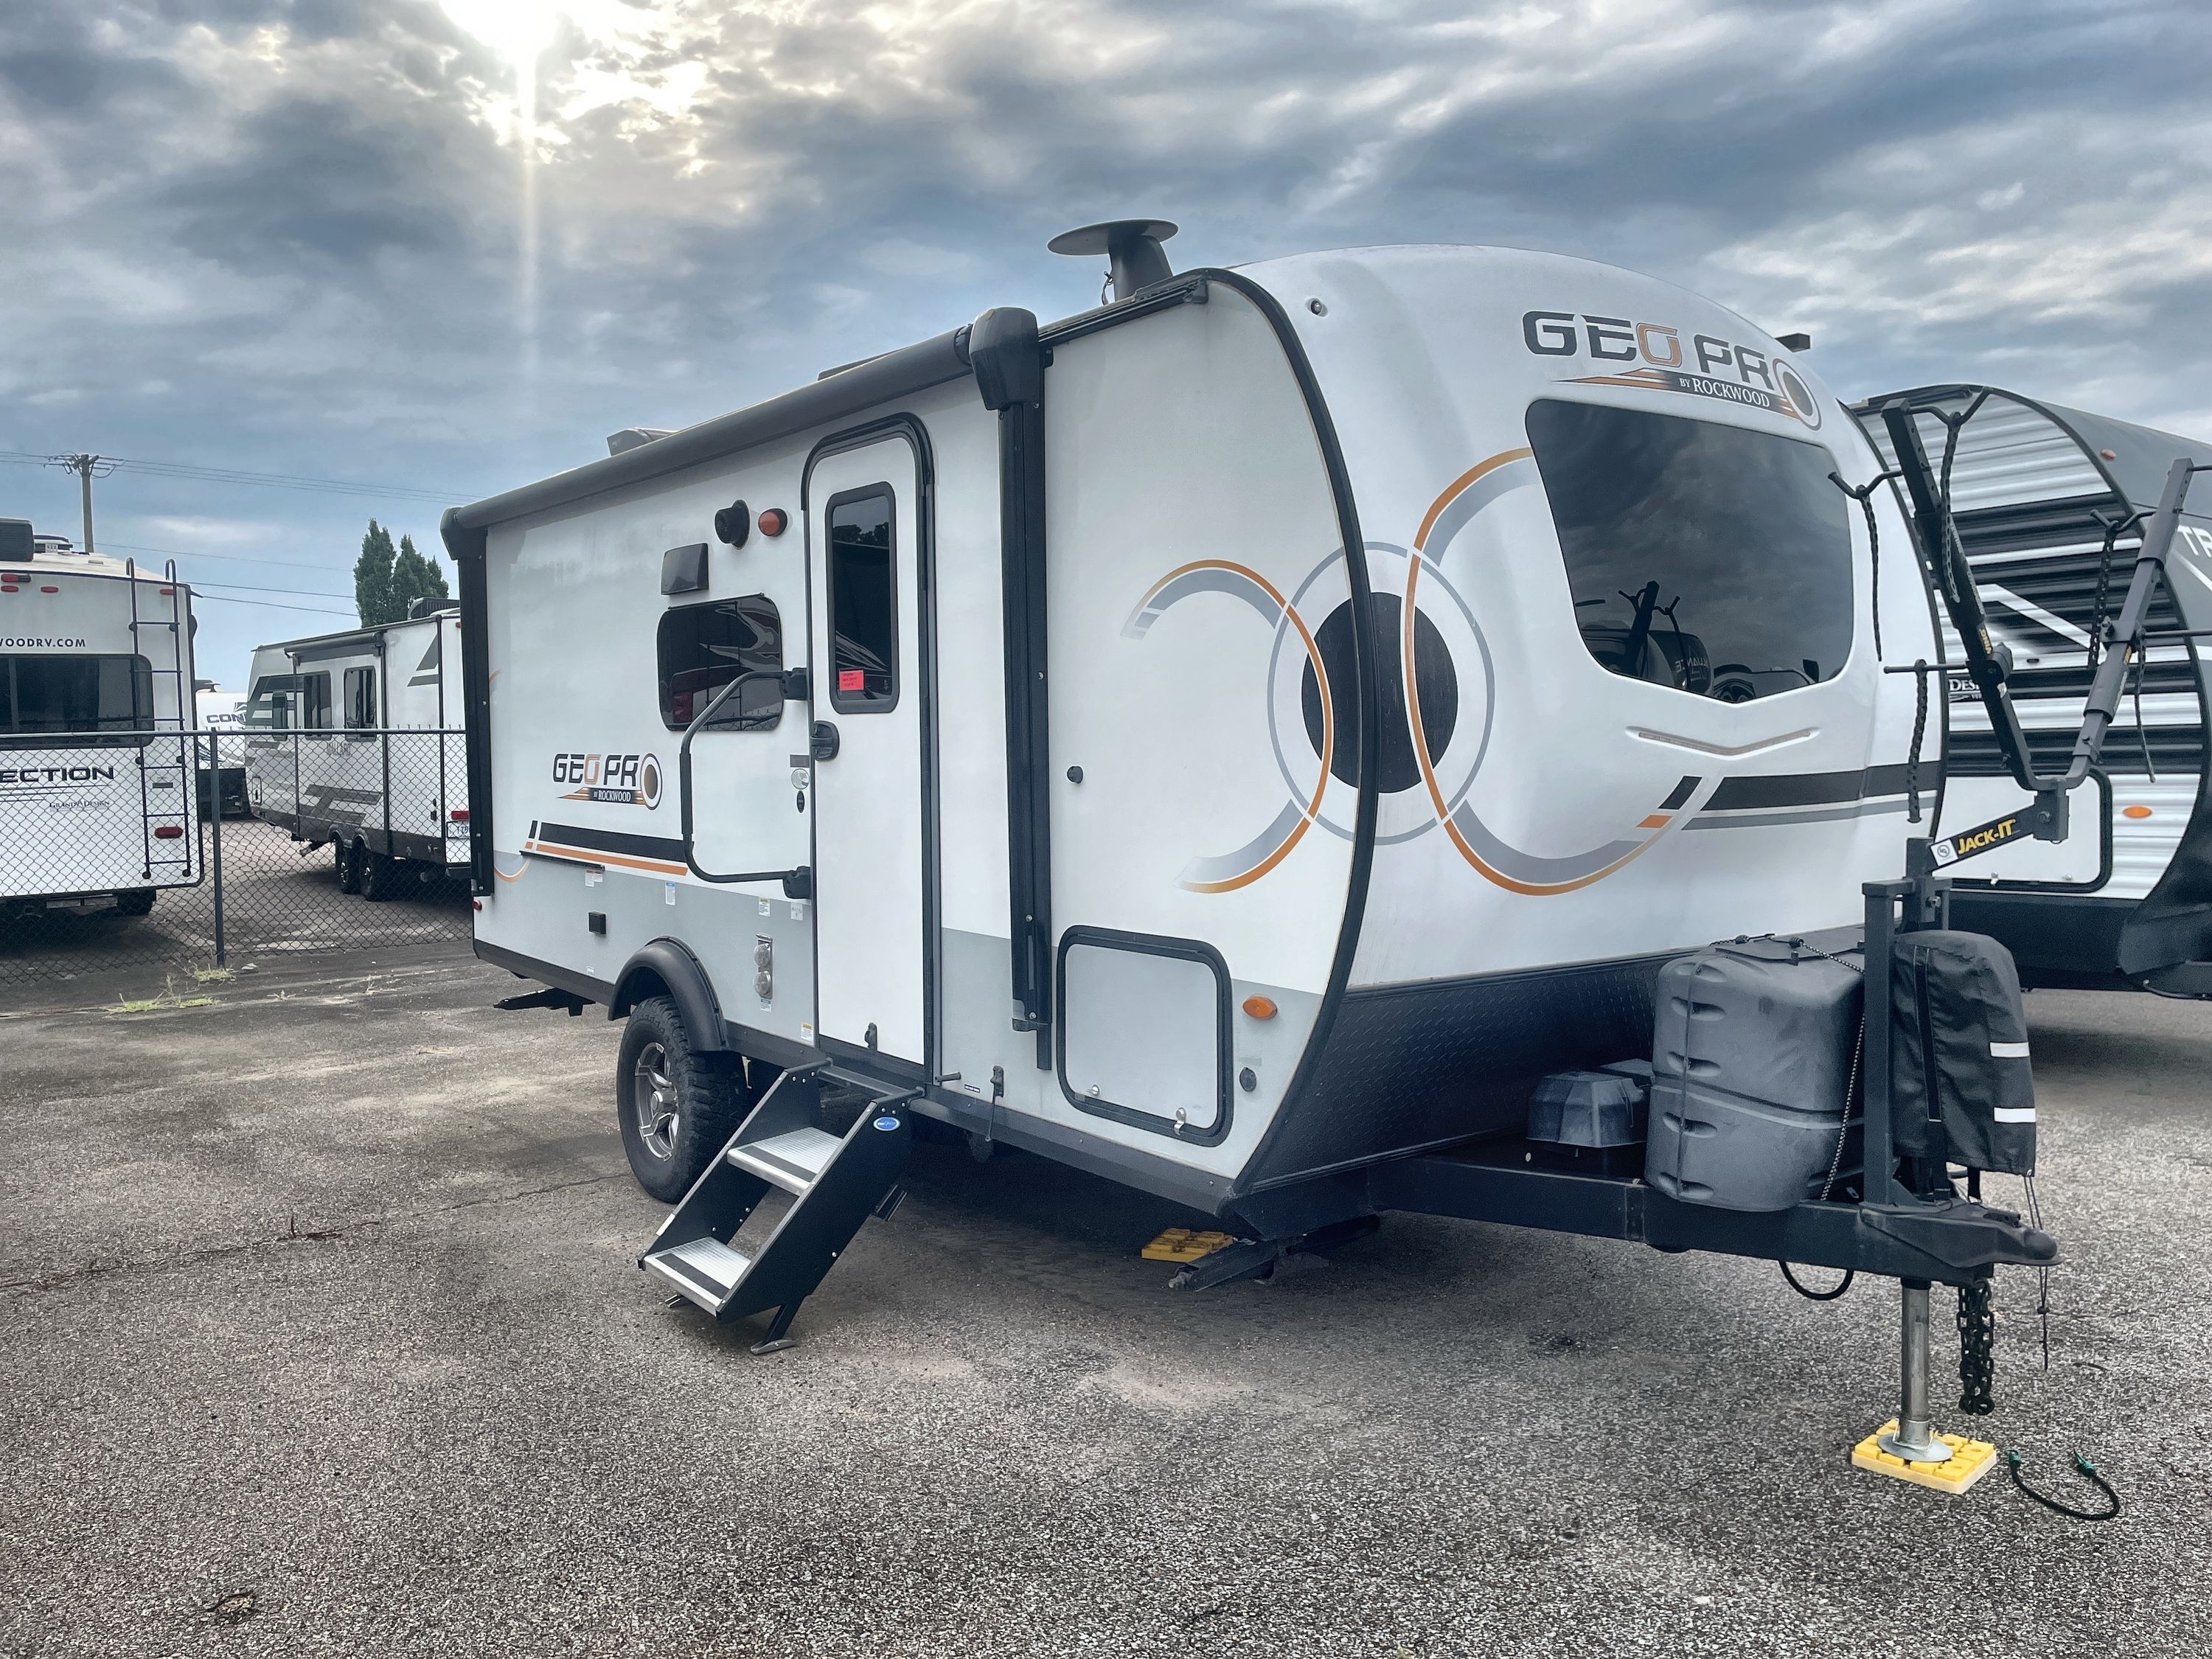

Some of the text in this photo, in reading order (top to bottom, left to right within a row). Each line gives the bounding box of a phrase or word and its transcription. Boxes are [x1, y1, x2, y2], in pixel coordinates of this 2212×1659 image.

[1523, 310, 1683, 367] GEO
[1680, 378, 1770, 408] BY ROCKWOOD
[0, 638, 86, 647] OODRV.COM
[553, 754, 602, 785] GEO
[598, 790, 631, 802] ROCKWOOD
[1958, 819, 2016, 855] JACK-IT
